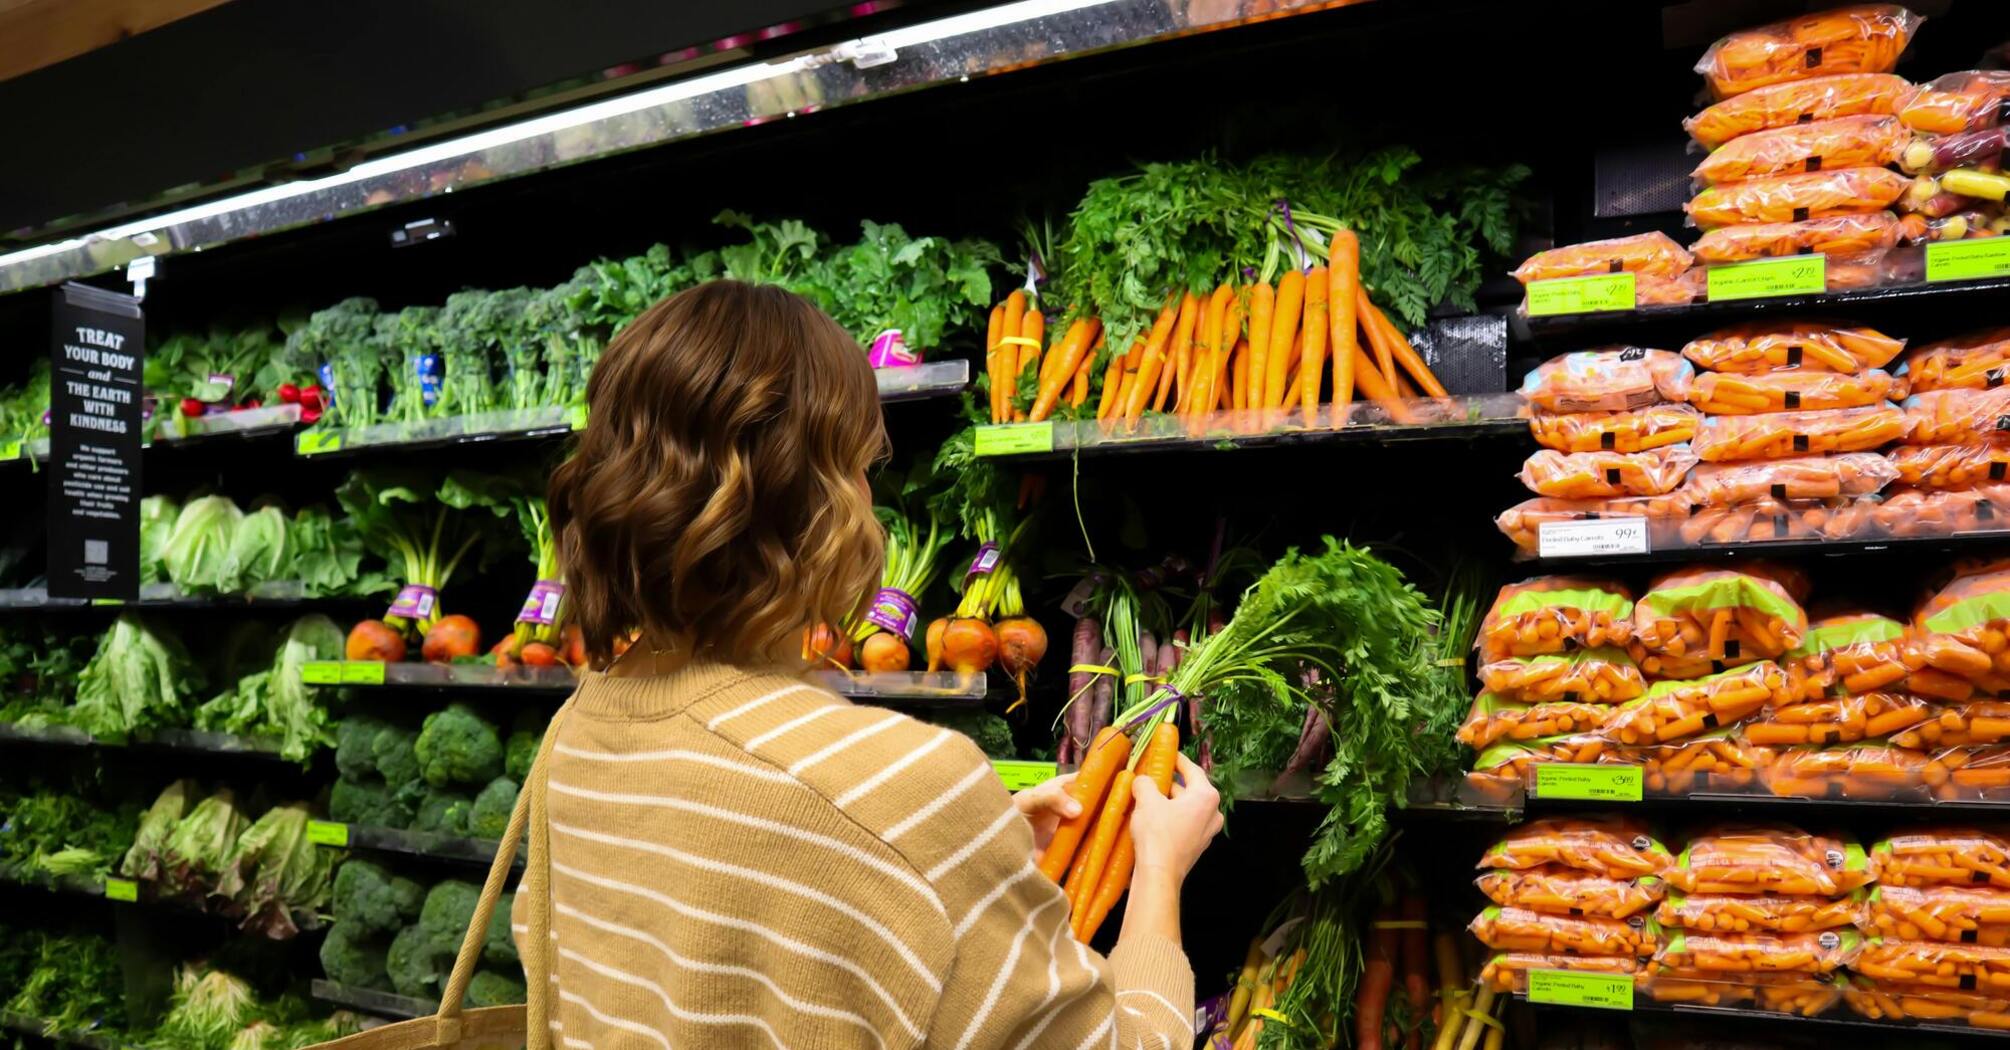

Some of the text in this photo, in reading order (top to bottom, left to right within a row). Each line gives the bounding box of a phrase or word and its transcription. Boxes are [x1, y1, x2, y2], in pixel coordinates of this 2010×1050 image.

[76, 327, 125, 350] TREAT
[64, 344, 135, 371] YOUR BODY
[87, 369, 112, 382] and
[66, 381, 131, 404] THE EARTH
[83, 400, 115, 417] WITH
[69, 413, 127, 434] KINDNESS
